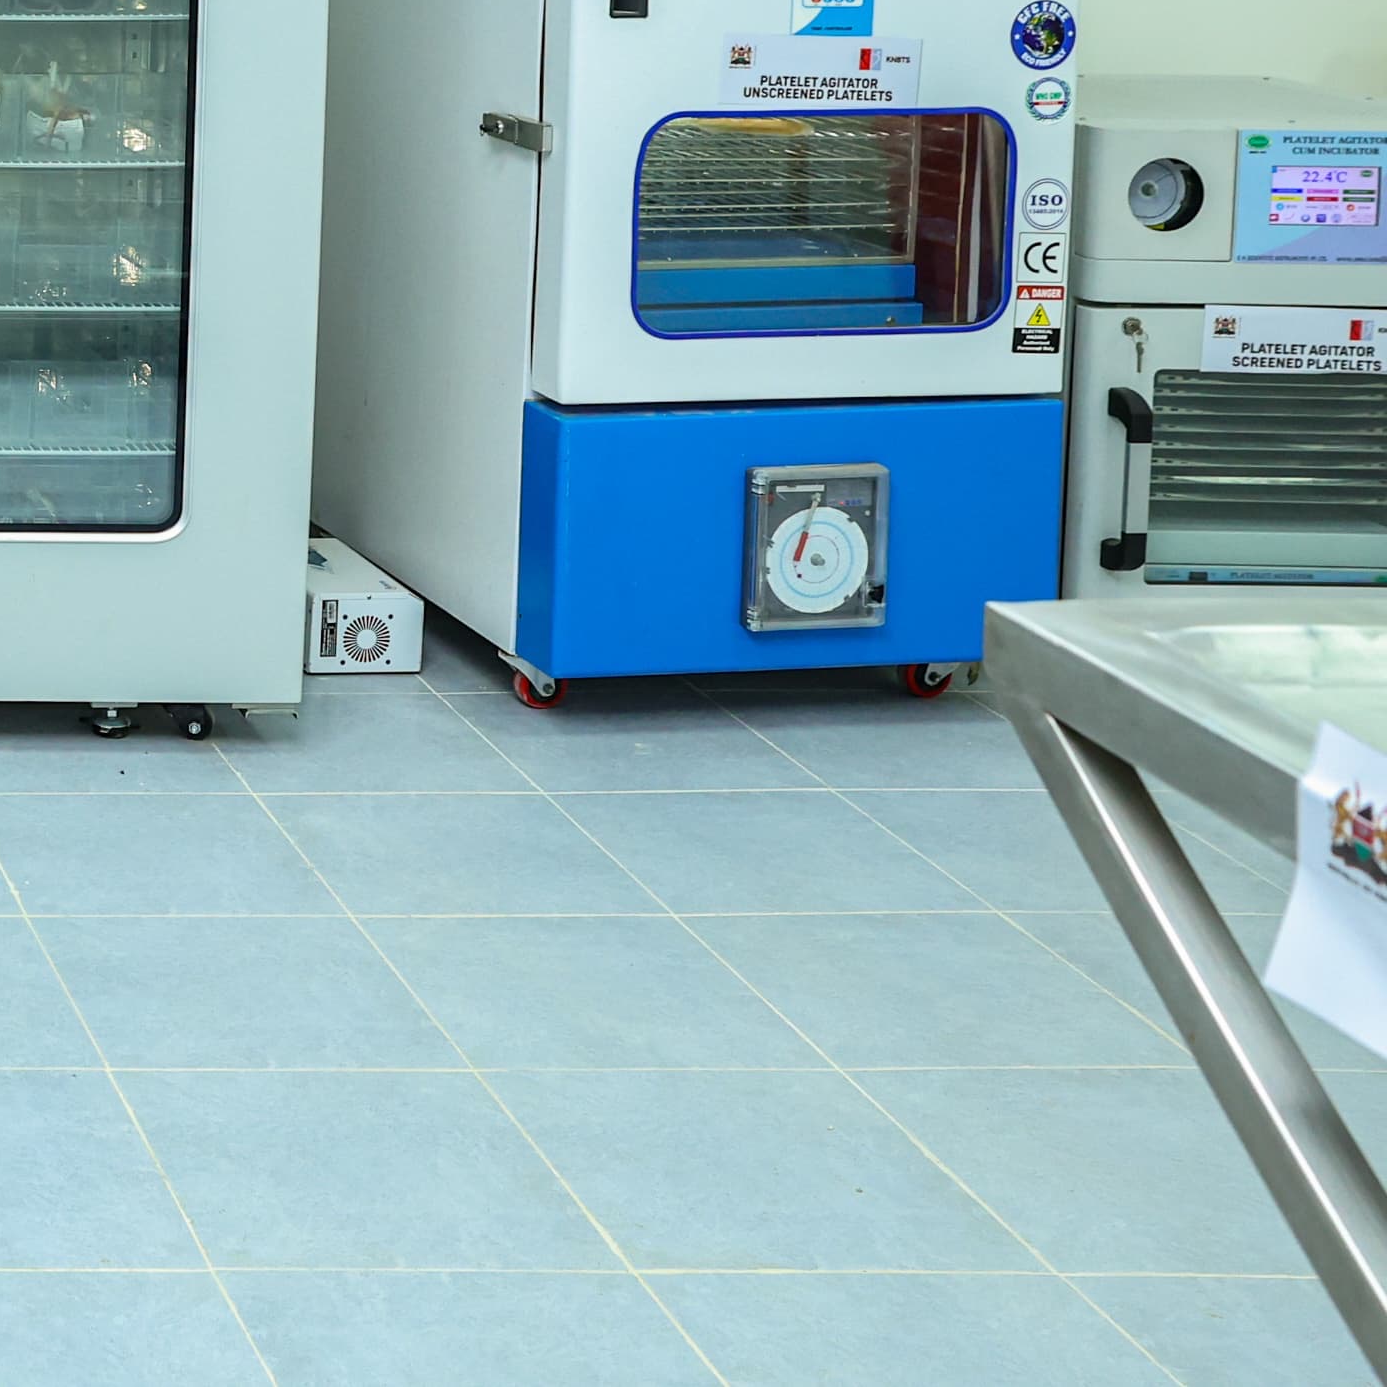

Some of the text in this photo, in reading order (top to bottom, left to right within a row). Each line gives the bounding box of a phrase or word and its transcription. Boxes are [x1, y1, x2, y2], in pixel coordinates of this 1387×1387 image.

[1017, 1, 1070, 24] CFC FREE
[886, 56, 911, 64] KNBTS
[760, 75, 878, 90] PLATELET AGITATOR
[743, 87, 893, 102] UNSCREENED PLATELETS
[1283, 136, 1335, 144] PLATELET
[1292, 147, 1380, 155] CUM INCUBATOR
[1030, 195, 1063, 206] ISO
[1024, 242, 1060, 274] CE
[1031, 288, 1062, 299] DANGER
[1241, 342, 1375, 357] PLATELET AGITATOR
[1232, 356, 1382, 371] SCREENED PLATELETS
